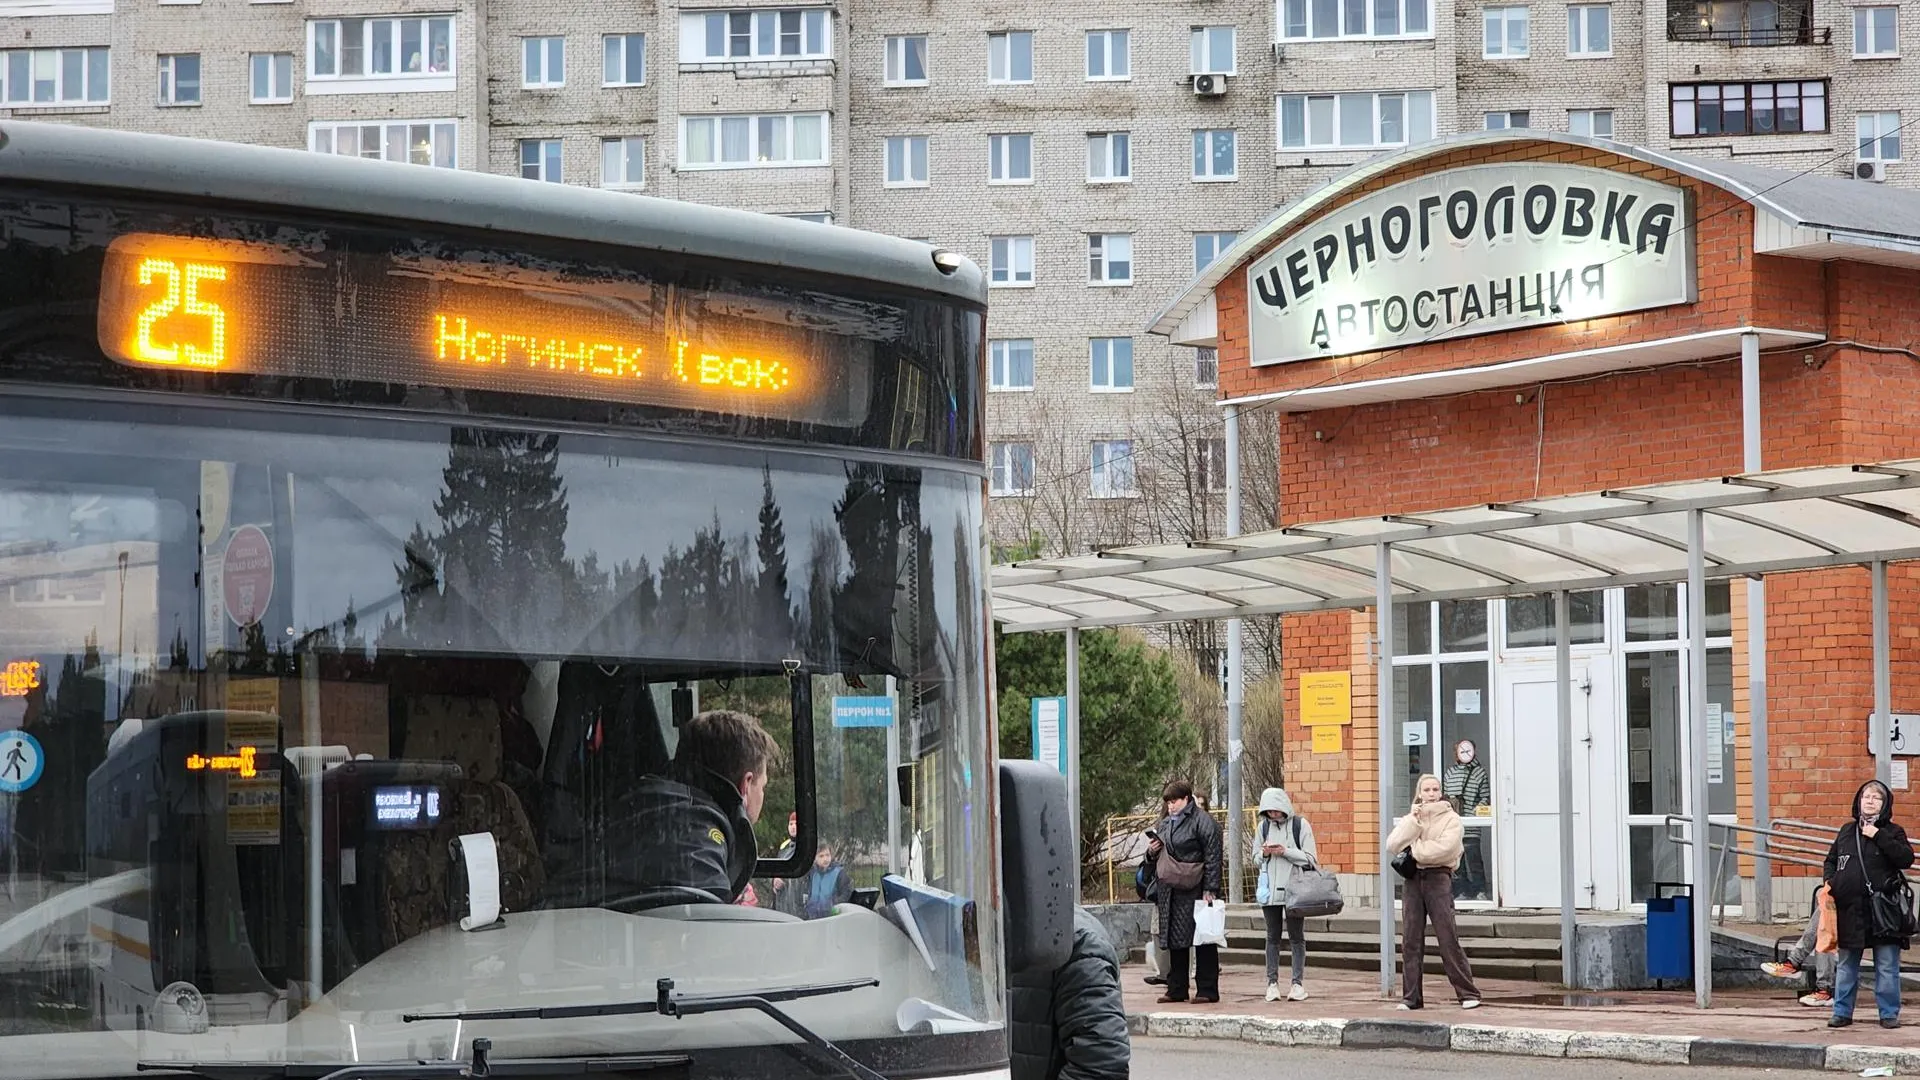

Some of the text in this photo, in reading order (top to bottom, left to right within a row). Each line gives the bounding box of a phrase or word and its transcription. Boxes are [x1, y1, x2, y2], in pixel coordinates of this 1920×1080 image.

[1256, 184, 1675, 309] ЧЕРНОГОЛОВКА
[137, 258, 226, 366] 25
[1310, 263, 1605, 345] АВТОСТАНЦИЯ
[435, 314, 643, 378] Ногинск
[837, 706, 892, 717] ПЕРРОН №1
